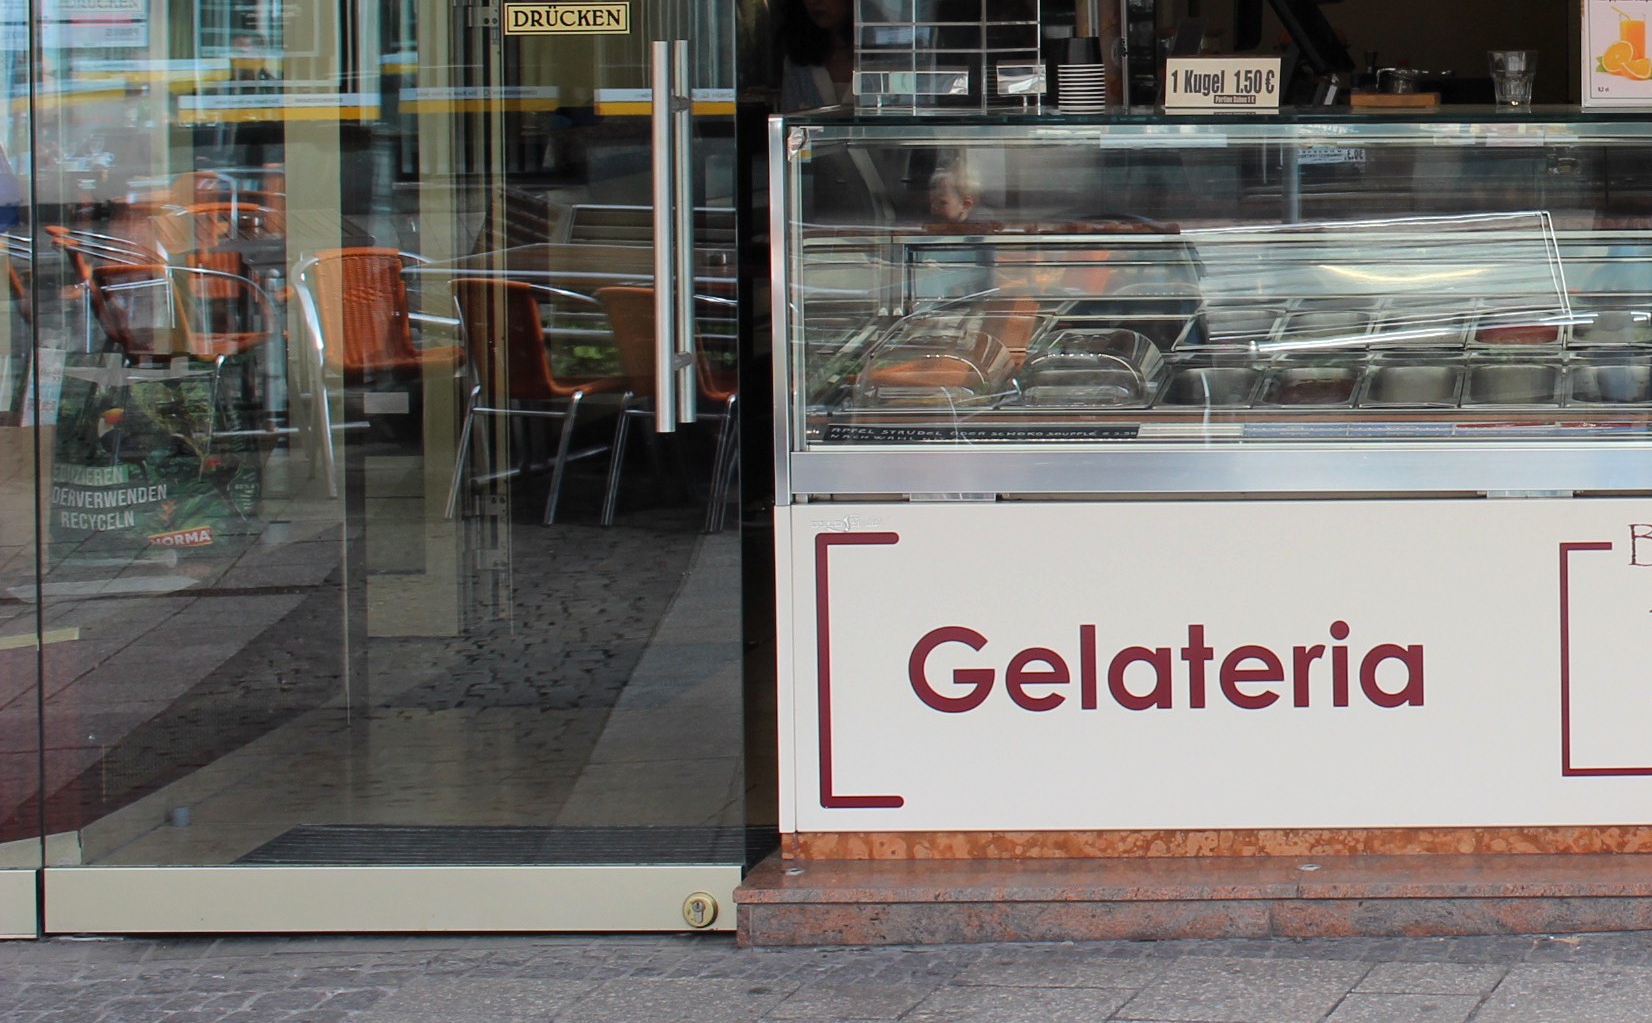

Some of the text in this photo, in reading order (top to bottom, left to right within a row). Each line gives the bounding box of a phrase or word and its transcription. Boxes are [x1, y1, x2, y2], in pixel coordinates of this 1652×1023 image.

[513, 5, 623, 28] DRÜCKEN
[1171, 69, 1275, 96] 1 Kugel 1.50 €
[61, 510, 135, 531] RECYCELN
[150, 529, 211, 547] NORMA
[908, 620, 1427, 714] Gelateria
